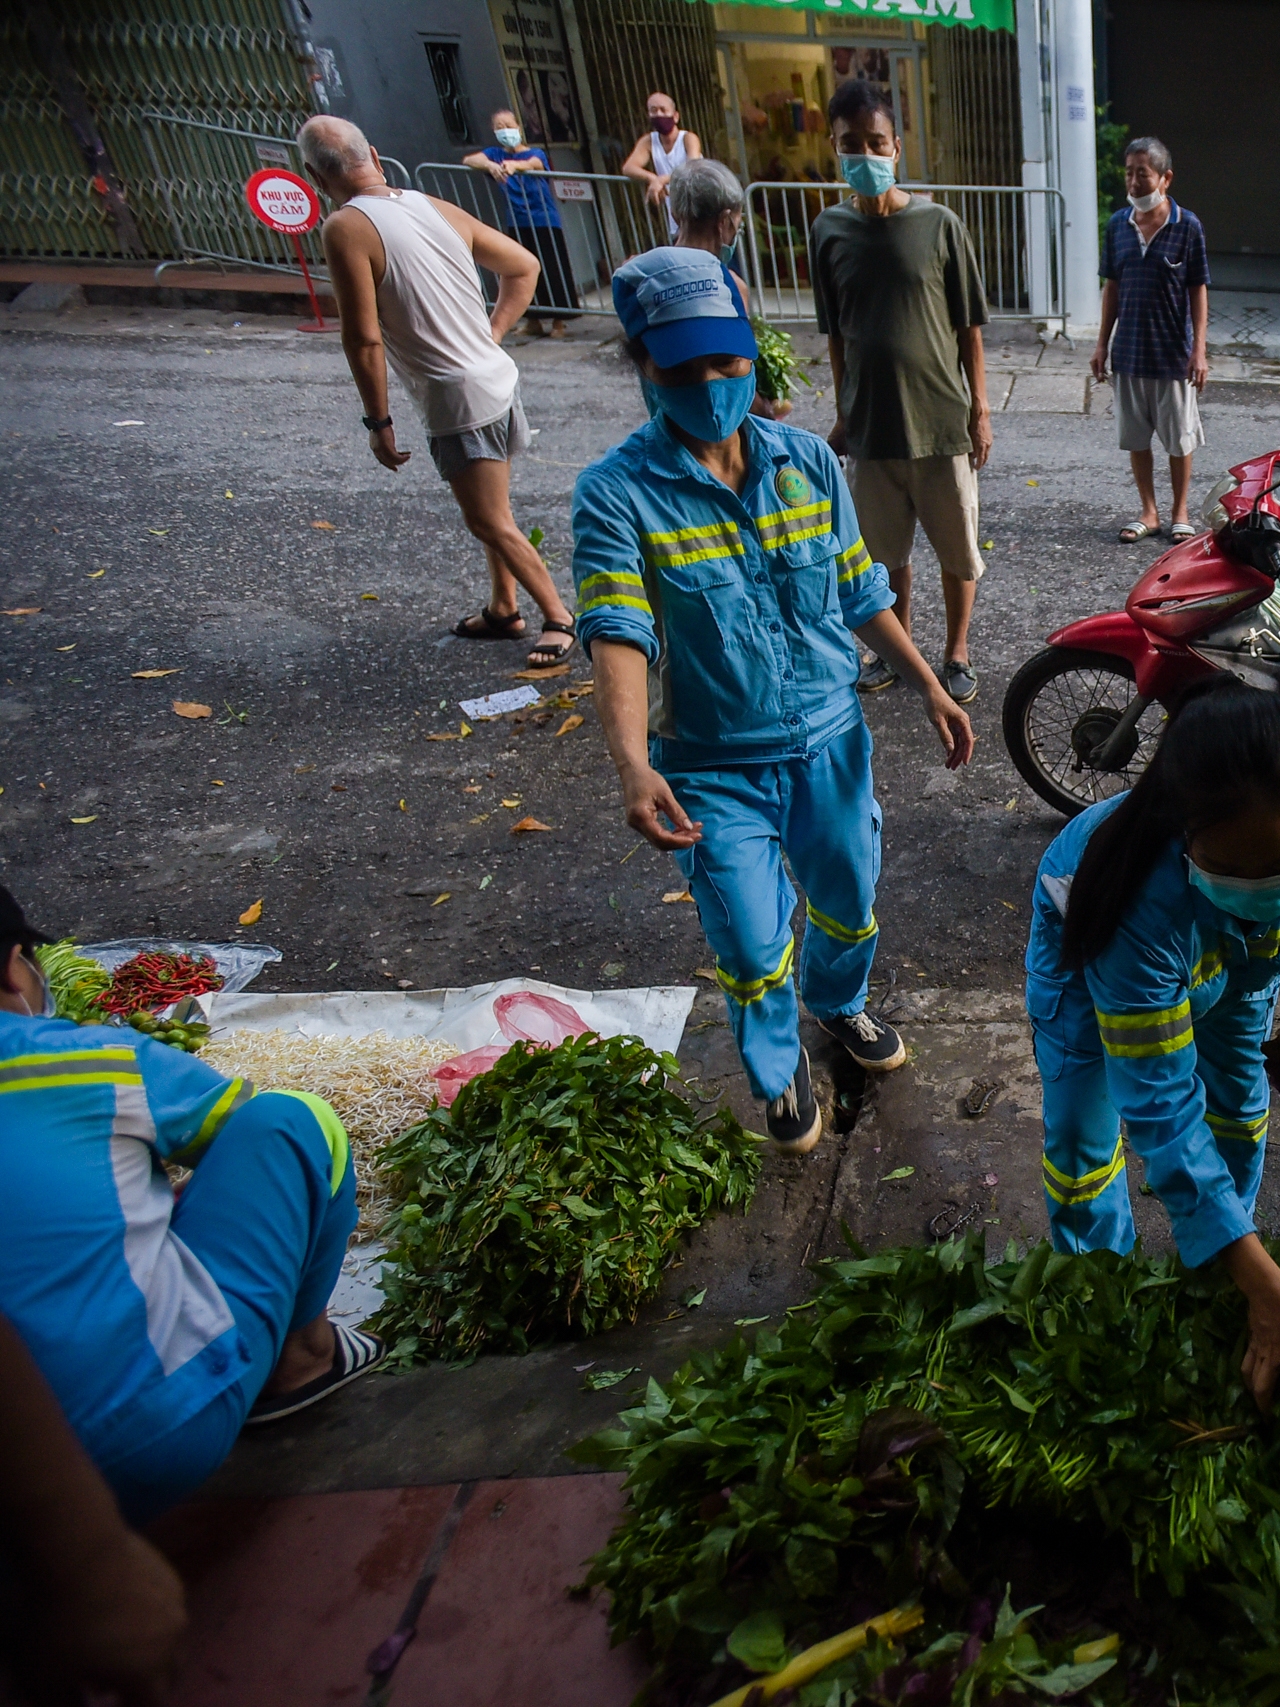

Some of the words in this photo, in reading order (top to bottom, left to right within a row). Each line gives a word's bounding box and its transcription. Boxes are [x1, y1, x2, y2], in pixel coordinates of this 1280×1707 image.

[260, 190, 282, 202] KHU
[283, 190, 305, 203] VỰC
[563, 188, 585, 197] STOP
[272, 222, 285, 232] NO
[285, 223, 309, 233] ENTRY
